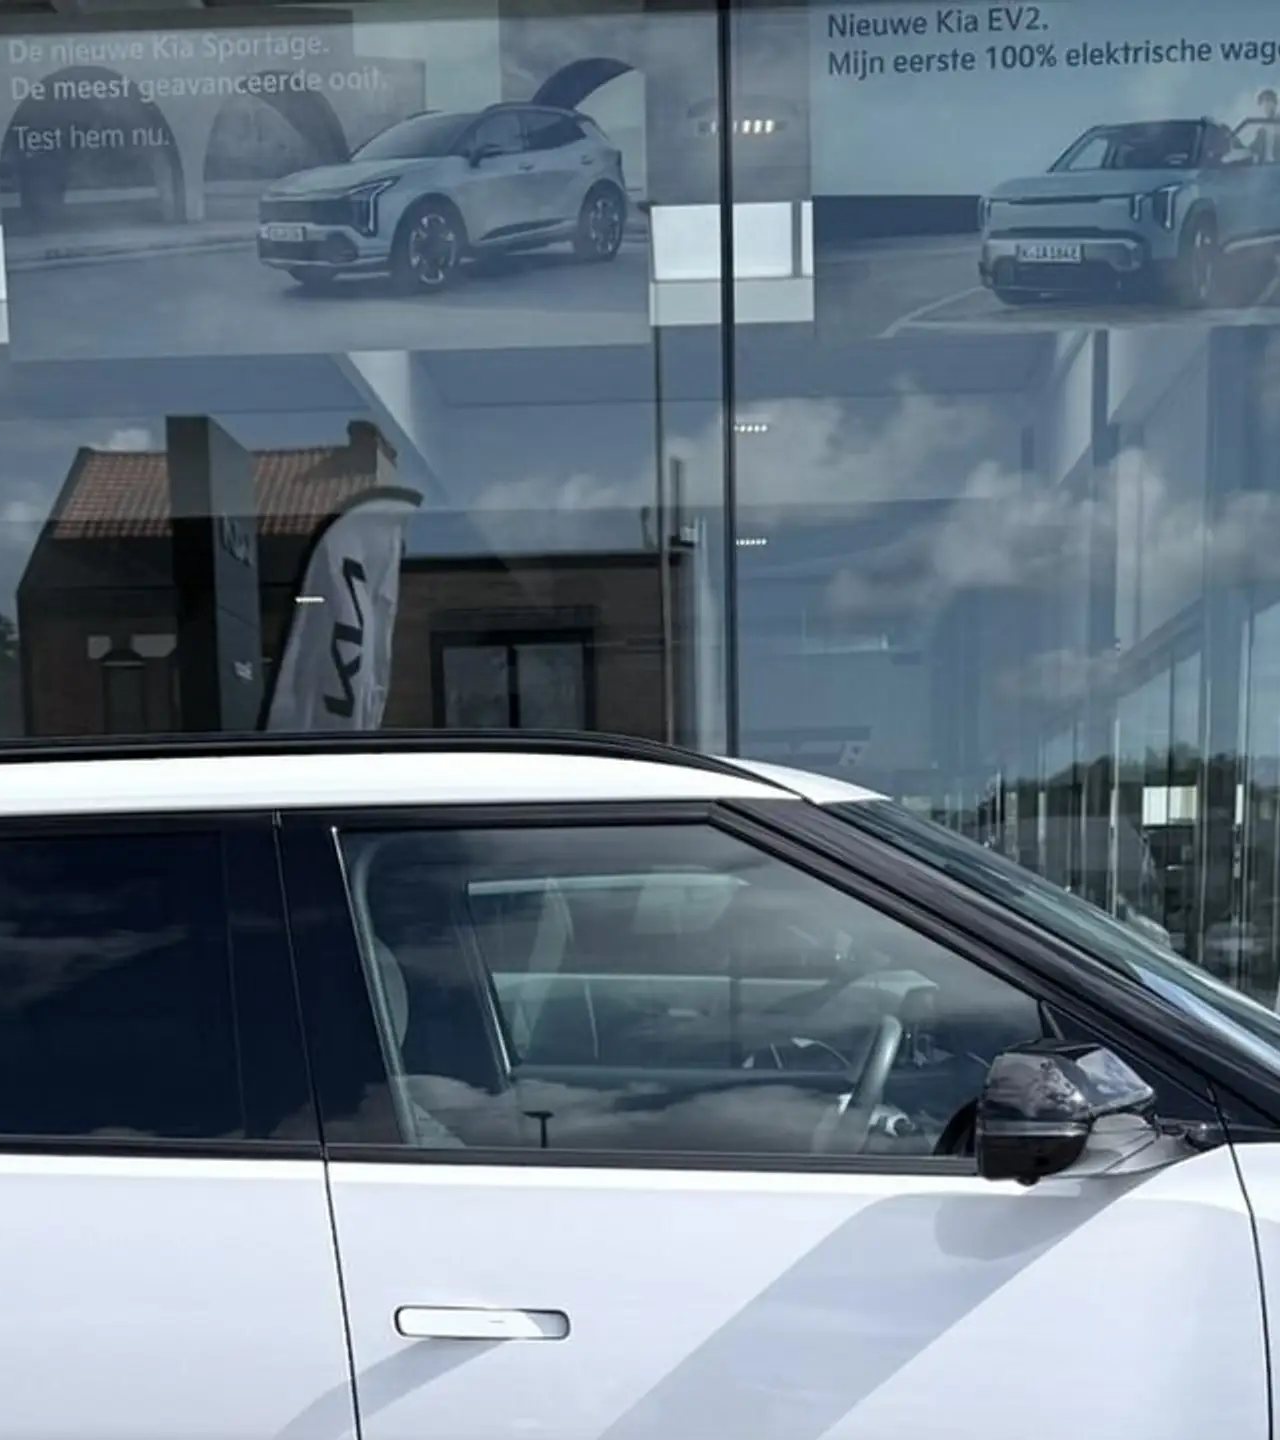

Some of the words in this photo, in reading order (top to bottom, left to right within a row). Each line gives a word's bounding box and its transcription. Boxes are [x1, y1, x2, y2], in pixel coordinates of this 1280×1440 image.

[828, 13, 927, 37] Nieuwe
[937, 10, 979, 33] Kia
[988, 7, 1049, 32] EV2.
[8, 40, 42, 64] De
[51, 37, 143, 63] nieuwe
[152, 34, 195, 60] Kia
[203, 32, 329, 62] Sportage.
[828, 50, 884, 80] Mijn
[893, 49, 976, 73] eerste
[985, 43, 1057, 68] 100%
[1065, 37, 1212, 66] elektrische
[11, 76, 46, 100] De
[53, 75, 131, 99] meest
[137, 68, 322, 103] geavanceerde
[328, 66, 387, 91] ooit.
[12, 126, 62, 150] Test
[71, 125, 124, 148] hem
[132, 127, 170, 146] nu.
